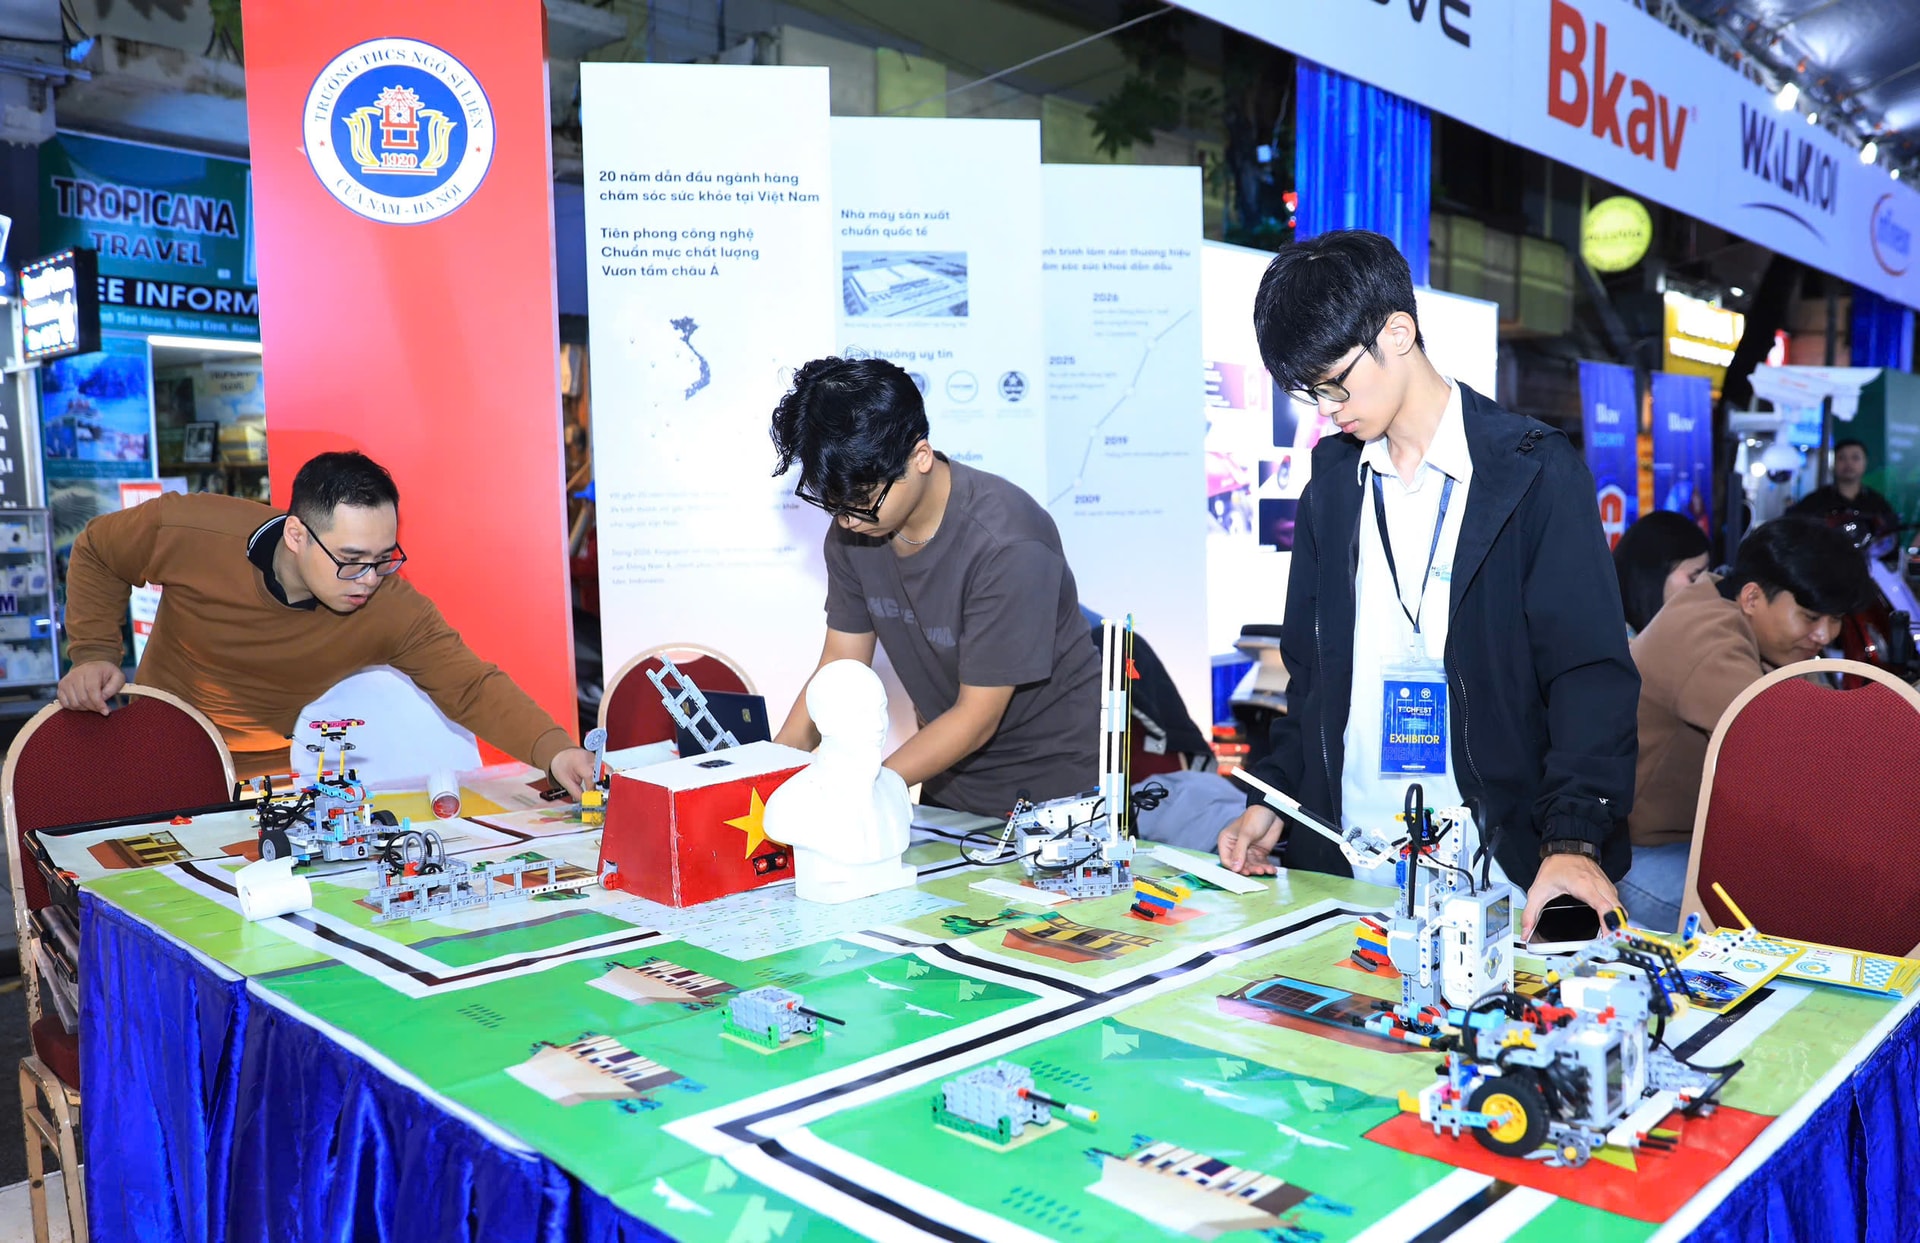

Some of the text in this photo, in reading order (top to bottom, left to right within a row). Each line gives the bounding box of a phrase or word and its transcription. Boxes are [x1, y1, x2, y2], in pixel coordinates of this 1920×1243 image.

[314, 62, 359, 123] TRƯỜNG
[360, 48, 406, 66] THCS
[1547, 0, 1689, 172] Bkav
[381, 153, 418, 168] 1920
[599, 170, 616, 182] 20
[620, 172, 650, 182] năm
[716, 172, 760, 186] ngành
[764, 172, 799, 186] hàng
[599, 189, 820, 204] chăm sóc sức khỏe tại Việt Nam
[52, 176, 239, 239] TROPICANA
[366, 197, 401, 216] NAM
[600, 227, 755, 242] Tiên phong công nghệ
[90, 231, 206, 267] TRAVEL
[601, 245, 760, 260] Chuẩn mực chất lượng
[601, 262, 720, 276] Vươn tầm châu Á
[1389, 734, 1440, 744] EXHIBITOR
